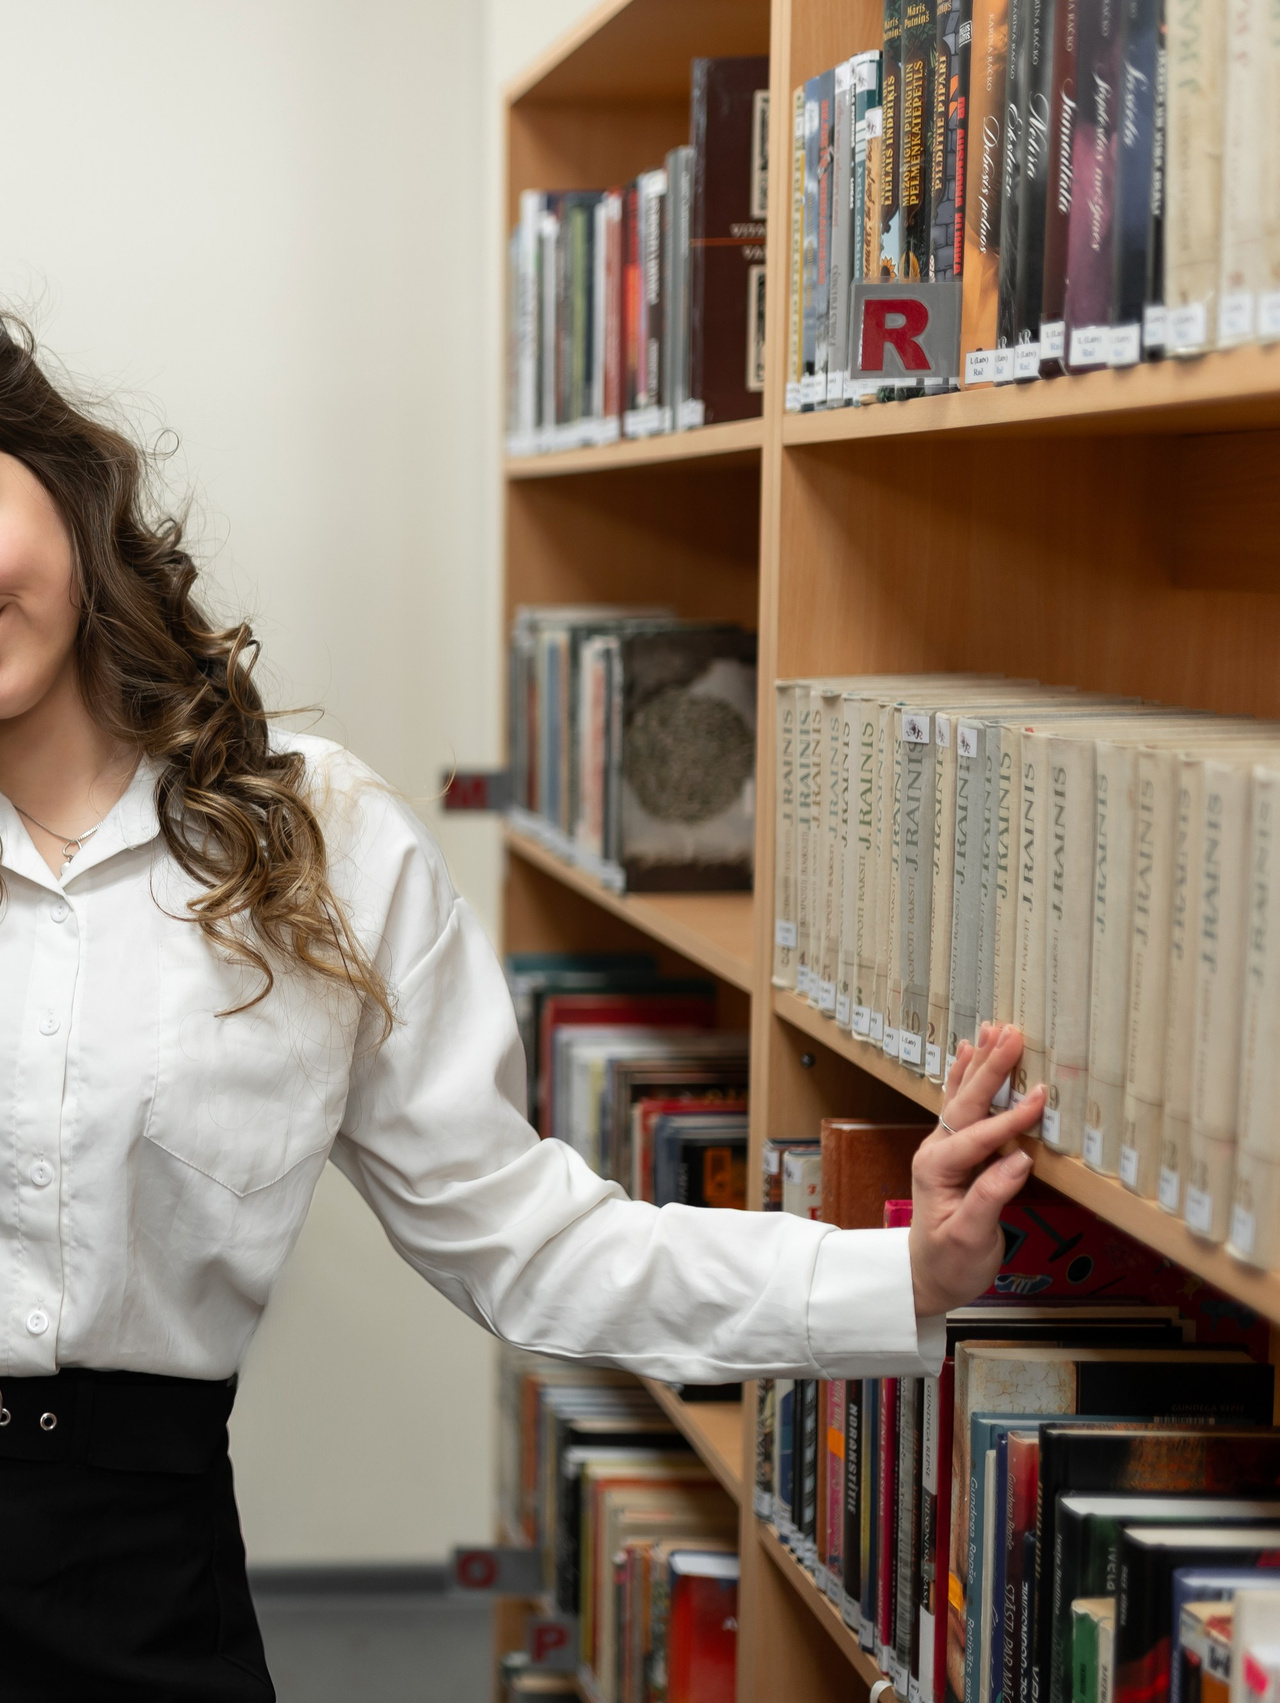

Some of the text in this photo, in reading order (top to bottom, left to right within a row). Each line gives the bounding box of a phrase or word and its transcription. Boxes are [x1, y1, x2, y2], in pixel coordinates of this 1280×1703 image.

[907, 3, 926, 16] Māris
[905, 62, 915, 86] UN
[938, 55, 947, 112] PIPARI
[860, 299, 932, 371] R
[444, 773, 489, 810] M
[858, 721, 875, 851] J.RAINIS
[995, 751, 1013, 900] J.RAINIS
[1022, 762, 1036, 914] J.RAINIS
[1052, 766, 1068, 921] J.RAINIS
[907, 874, 916, 984] KOPOTI RAKSTI
[925, 1384, 933, 1443] GUNDEGA
[847, 1402, 859, 1515] NORAKSTĪTIE
[969, 1476, 978, 1538] Gundega
[1007, 1471, 1017, 1519] Gundega
[966, 1541, 977, 1585] Repše
[1004, 1583, 1017, 1633] STĀSTI
[532, 1623, 568, 1664] P
[965, 1616, 975, 1674] Retināts
[1003, 1634, 1014, 1667] PAR
